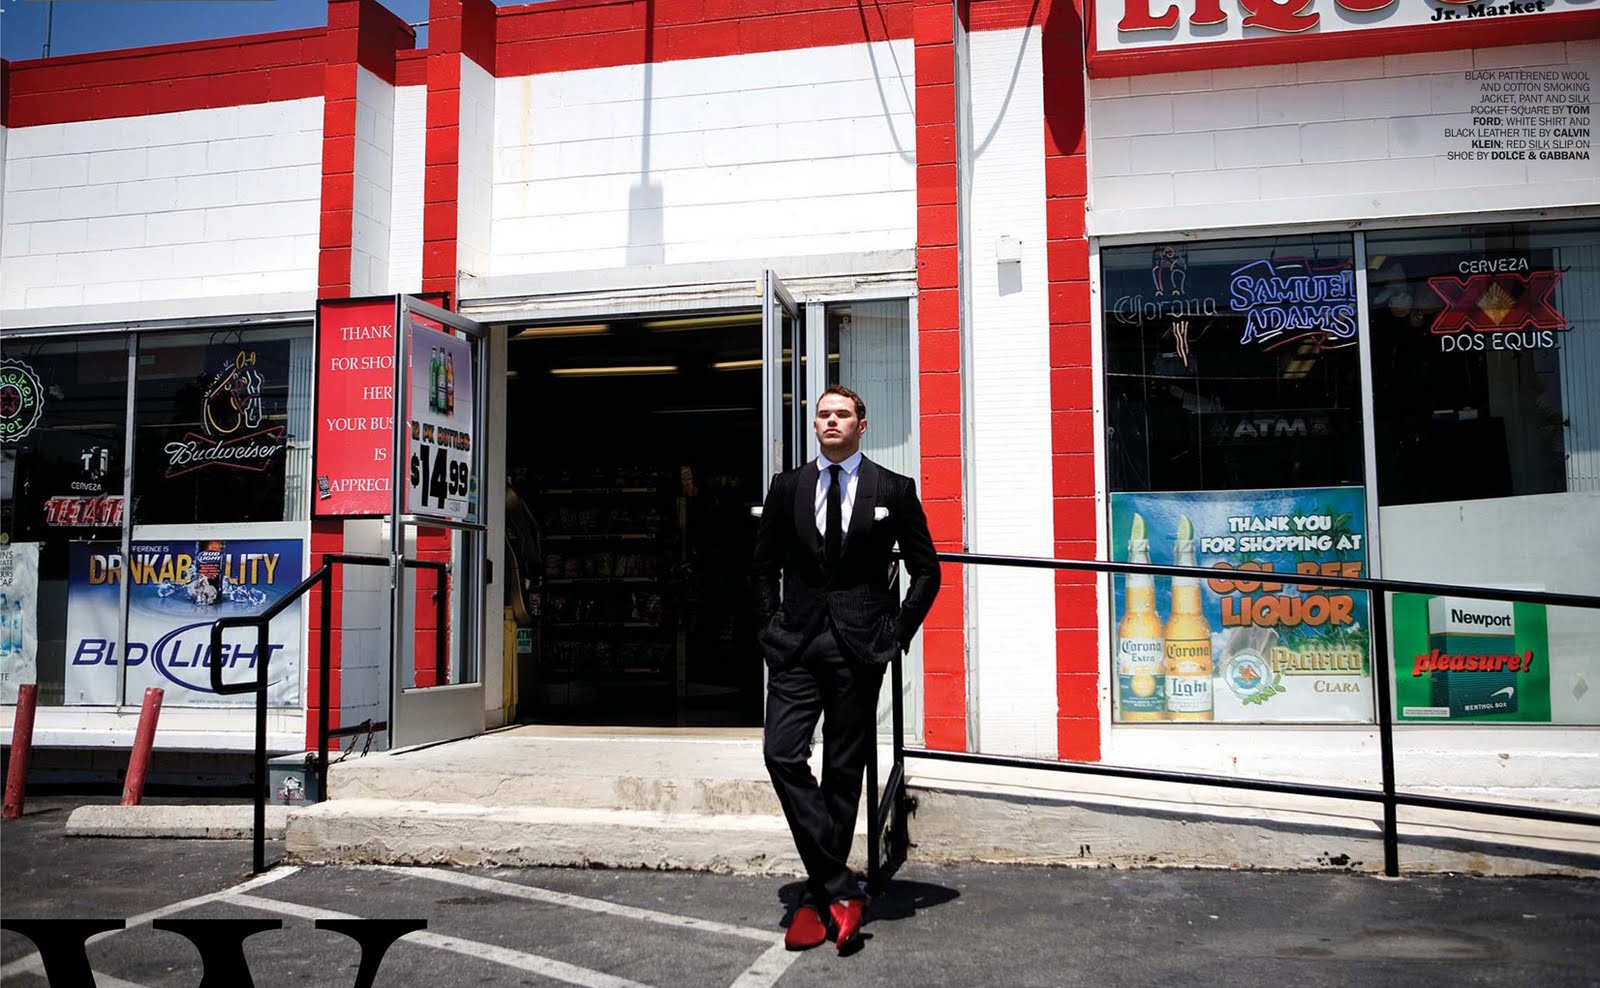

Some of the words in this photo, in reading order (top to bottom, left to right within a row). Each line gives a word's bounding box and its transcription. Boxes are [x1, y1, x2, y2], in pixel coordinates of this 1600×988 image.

[1431, 7, 1461, 21] Jr.
[1467, 0, 1545, 18] Market
[1458, 257, 1529, 274] CERVEZA
[1230, 270, 1357, 311] SAMUEL
[340, 325, 392, 341] THANK
[1240, 304, 1356, 345] ADAMS
[1441, 333, 1485, 352] DOS
[1492, 330, 1554, 351] EQUIS
[330, 357, 359, 371] FOR
[363, 386, 393, 400] HER
[326, 417, 367, 431] YOUR
[1233, 418, 1308, 438] ATM
[164, 440, 283, 465] Budweiser
[374, 448, 387, 461] IS
[1228, 515, 1290, 532] THANK
[1292, 514, 1332, 531] YOU
[1200, 536, 1236, 553] FOR
[1239, 535, 1333, 553] SHOPPING
[1336, 534, 1362, 550] AT
[1220, 594, 1355, 627] LIQUOR
[1451, 608, 1512, 628] Newport
[1121, 640, 1161, 654] Corona
[1166, 644, 1209, 659] Corona
[1411, 648, 1534, 678] pleasure!
[1464, 703, 1494, 711] MENTHOL
